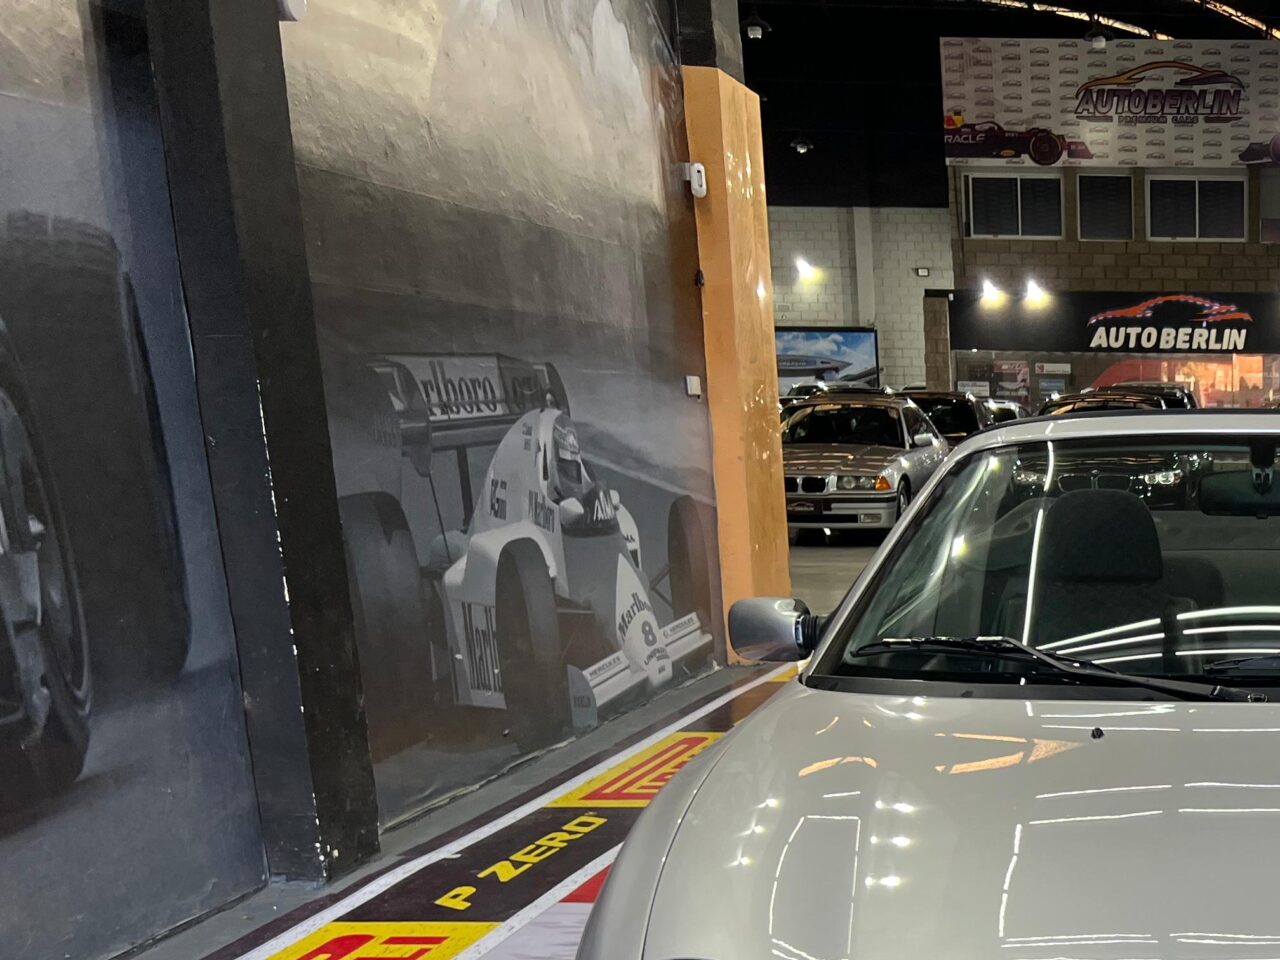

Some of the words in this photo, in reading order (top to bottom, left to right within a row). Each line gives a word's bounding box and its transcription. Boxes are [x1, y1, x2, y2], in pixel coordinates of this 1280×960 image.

[1075, 89, 1242, 115] AUTOBERLIN
[641, 620, 657, 647] 8
[434, 886, 477, 910] P
